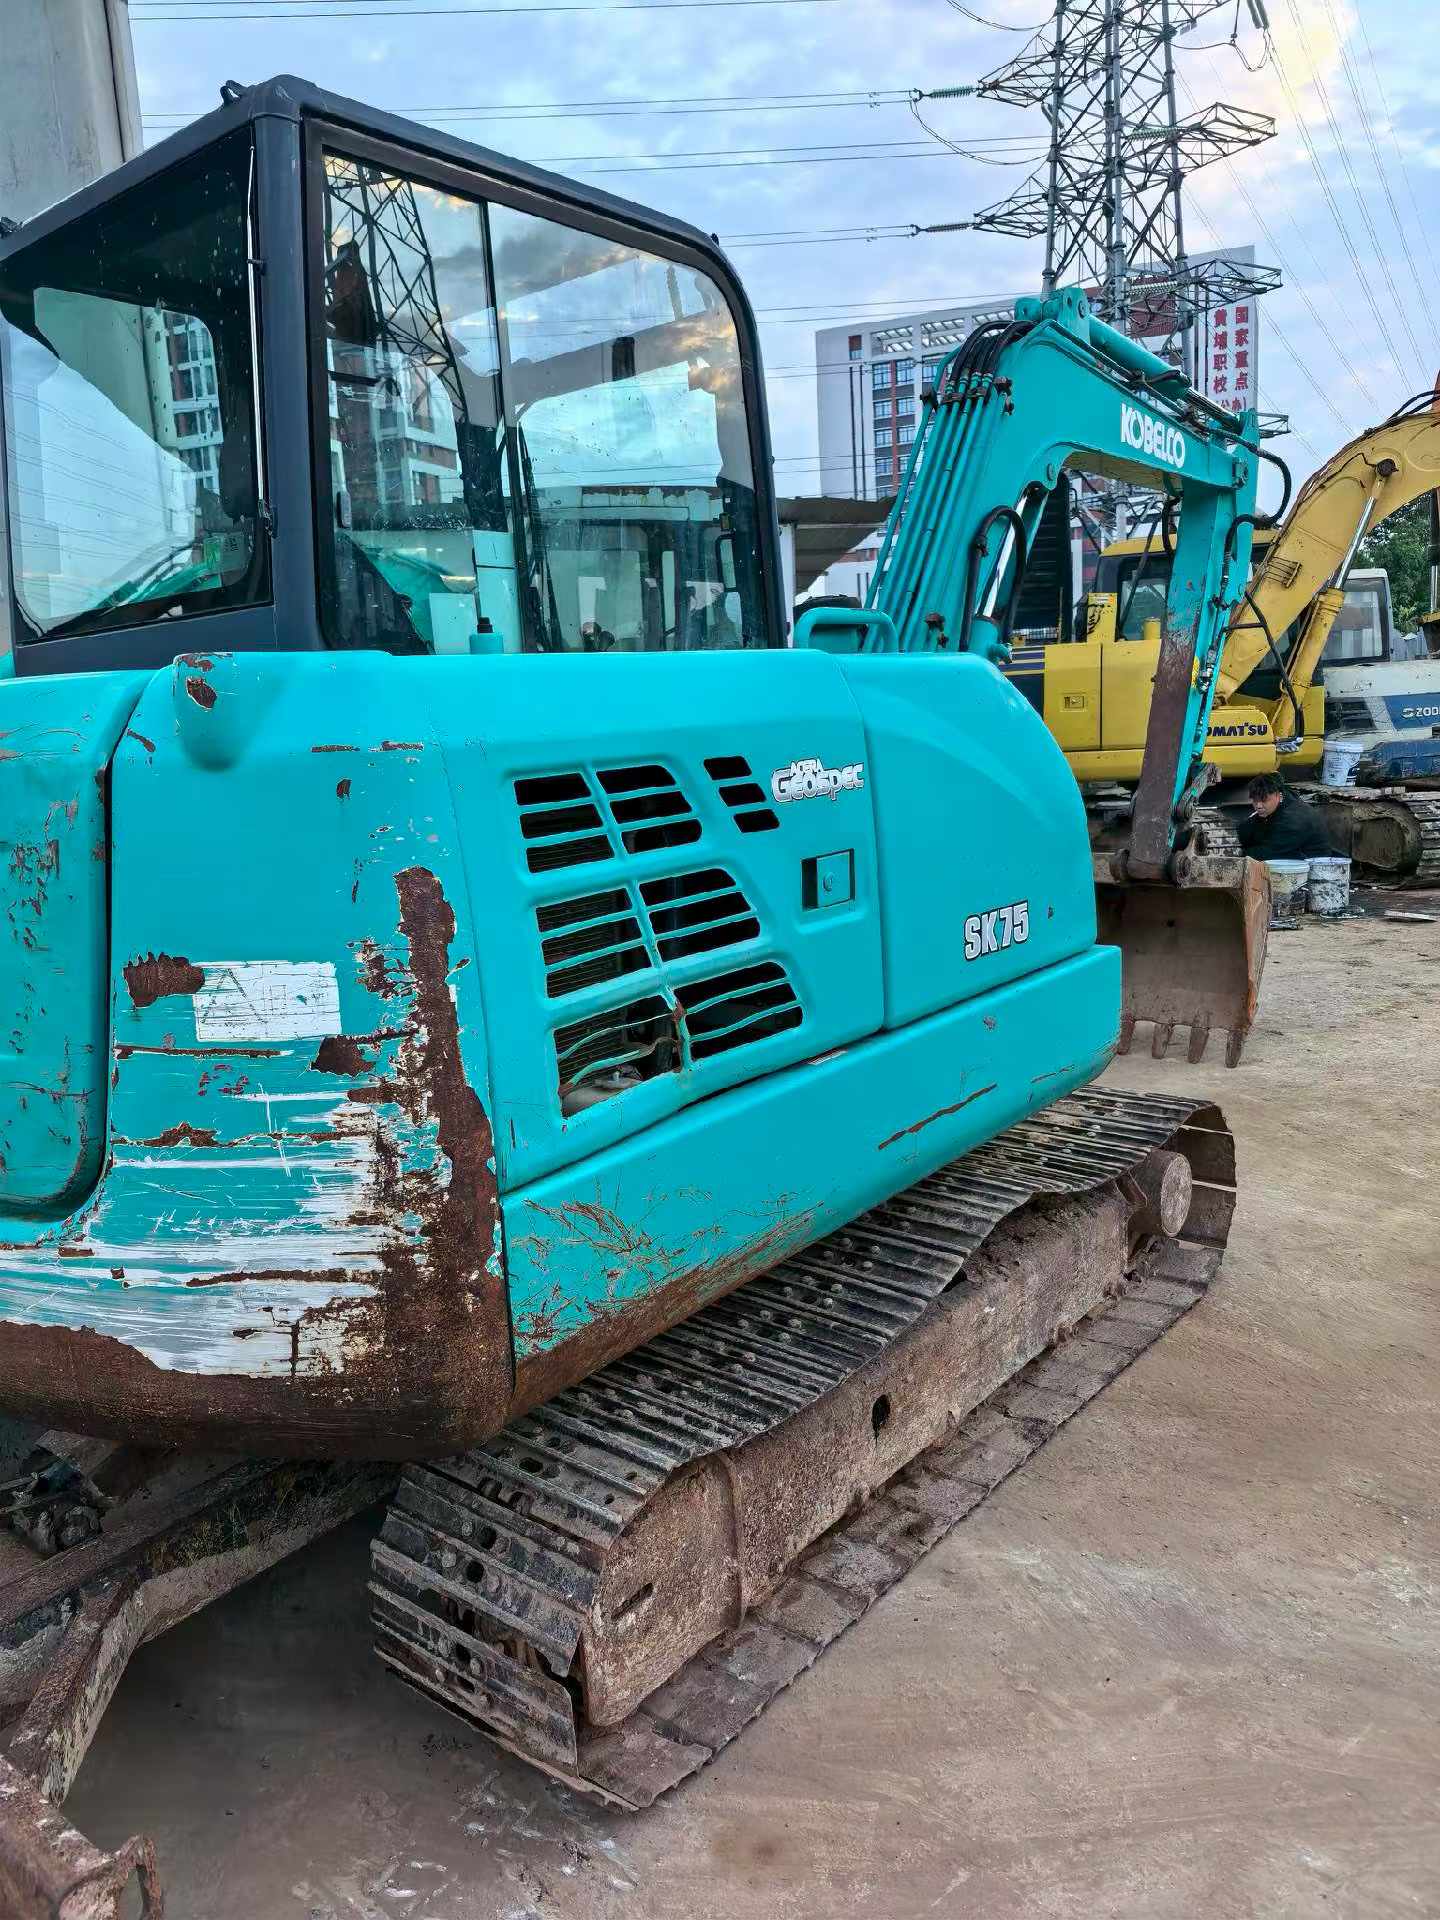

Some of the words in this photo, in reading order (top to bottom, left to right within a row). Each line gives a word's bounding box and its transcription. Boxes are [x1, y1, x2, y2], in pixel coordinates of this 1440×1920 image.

[1235, 305, 1249, 391] 国家重点
[1120, 402, 1186, 469] KOBELCO
[1206, 723, 1268, 737] MATSU
[963, 900, 1030, 961] SK75
